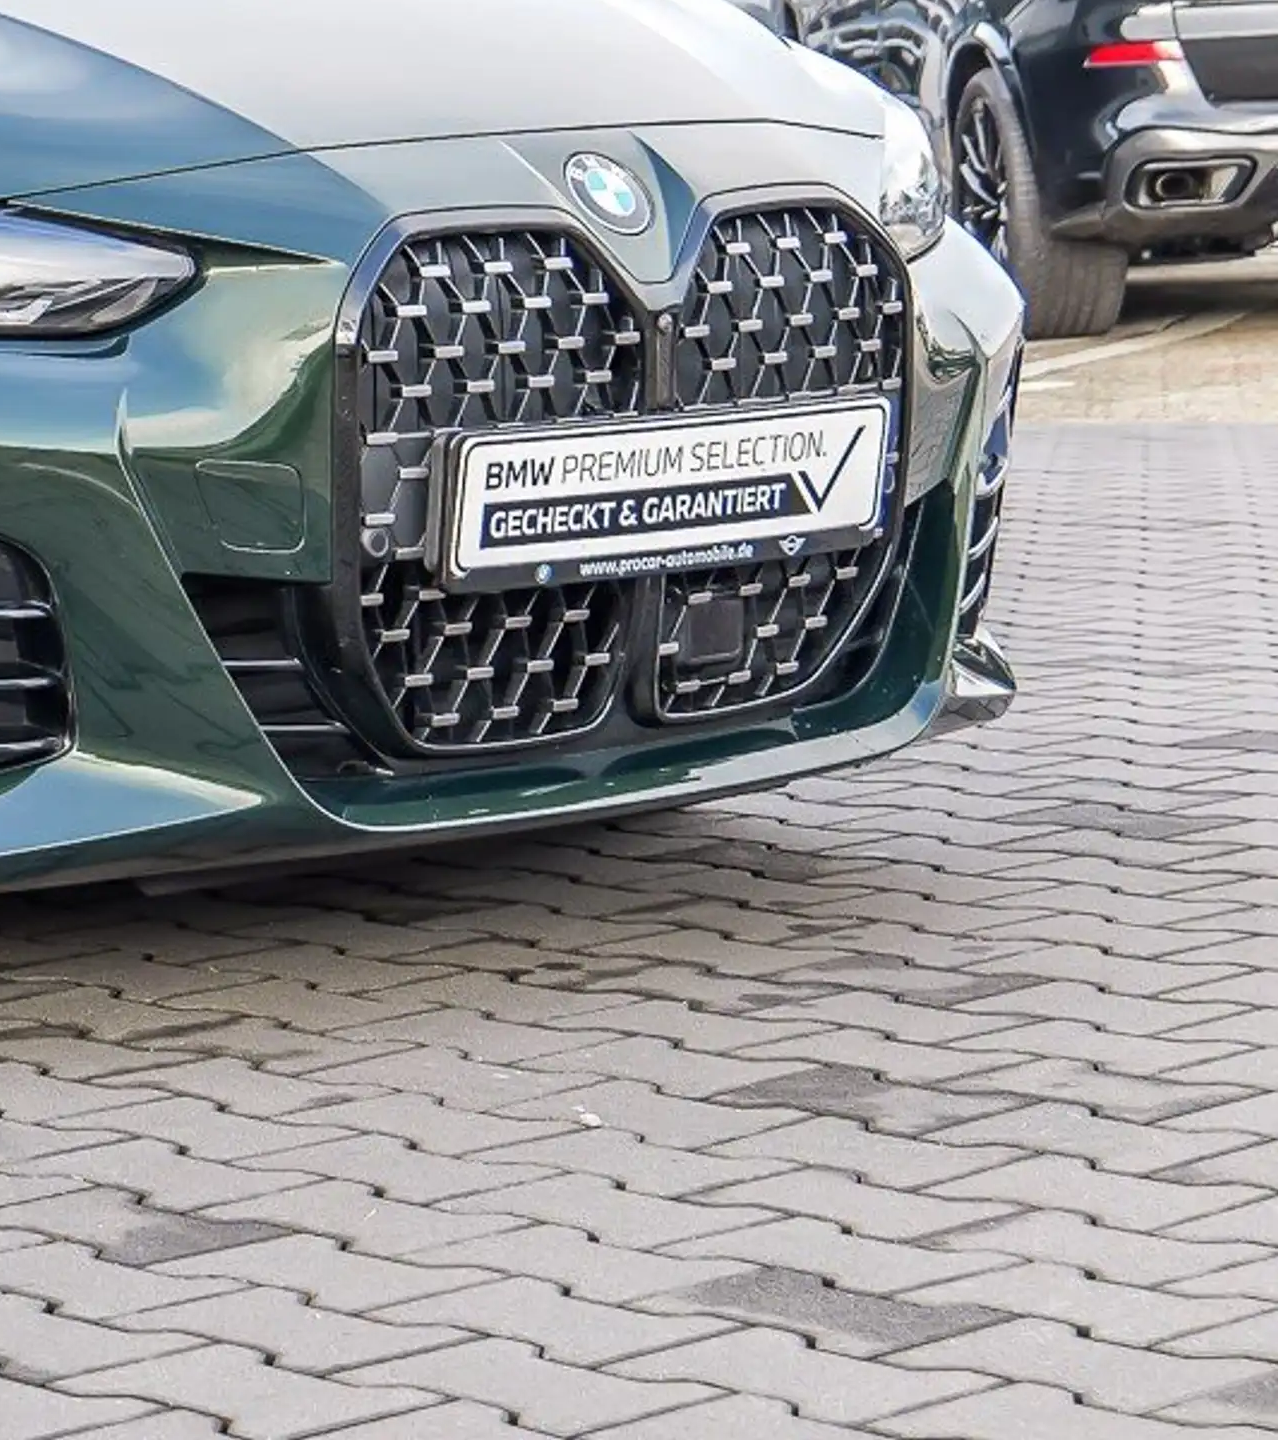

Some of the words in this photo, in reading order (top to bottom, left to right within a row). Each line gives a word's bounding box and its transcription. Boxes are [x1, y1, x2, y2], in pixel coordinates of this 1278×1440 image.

[485, 456, 555, 491] BMW
[561, 446, 684, 484] PREMIUM
[690, 430, 827, 472] SELECTION.
[489, 501, 616, 539] GECHECKT
[618, 499, 638, 526] &
[642, 483, 787, 524] GARANTIERT
[579, 543, 754, 577] www.procar-automobile.de
